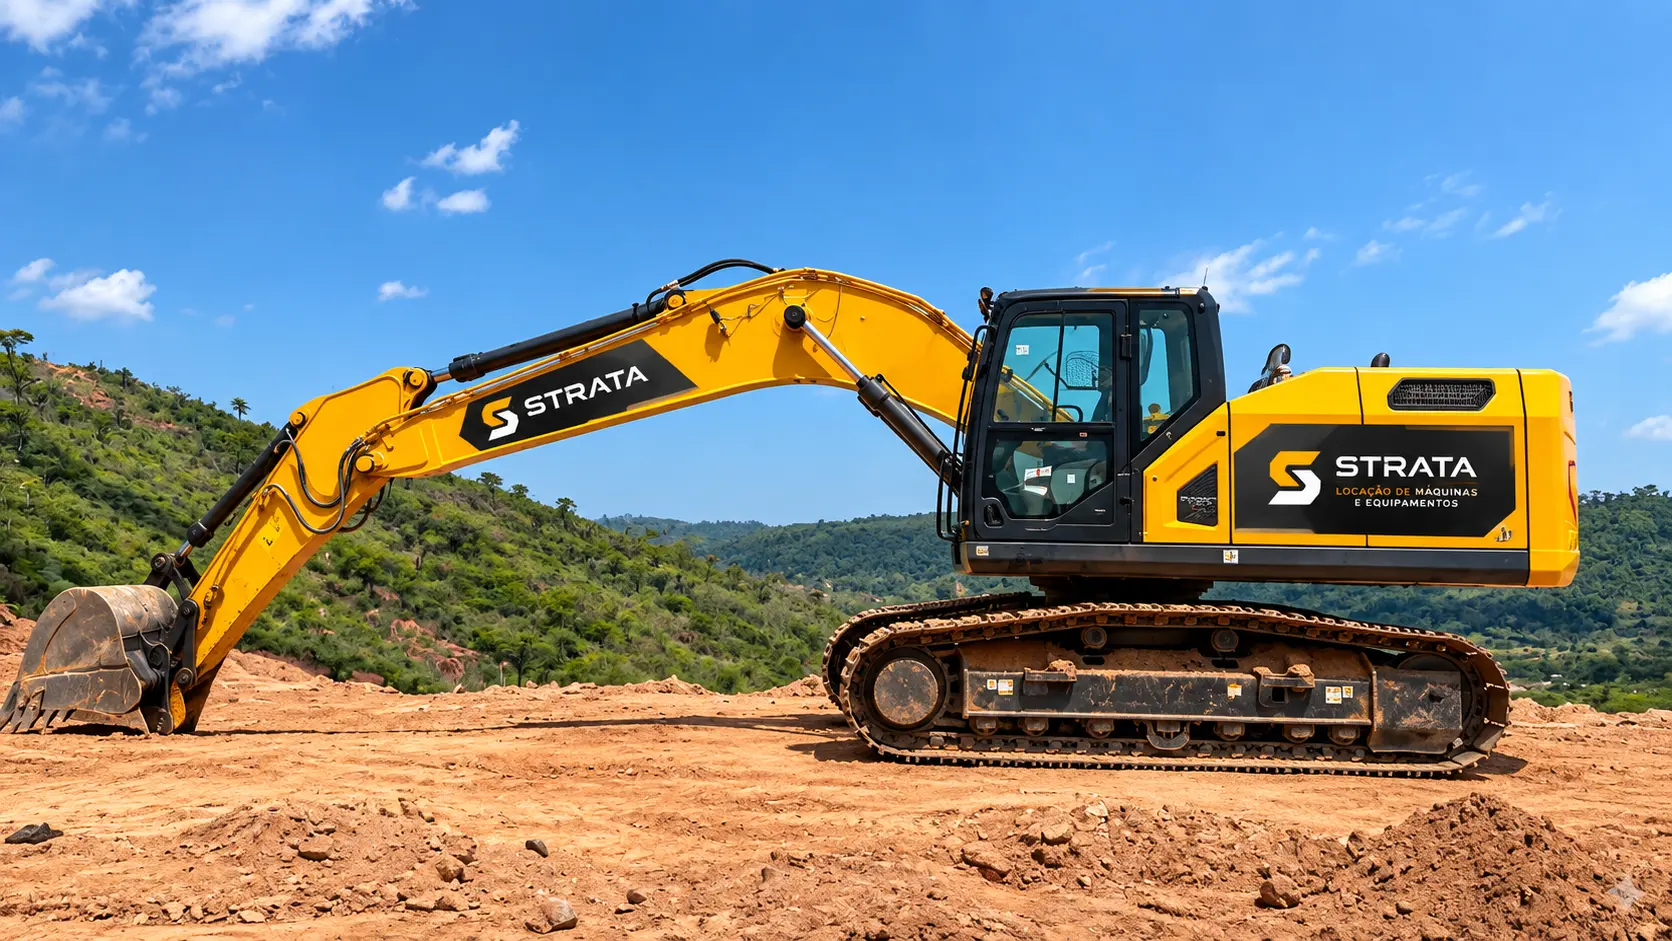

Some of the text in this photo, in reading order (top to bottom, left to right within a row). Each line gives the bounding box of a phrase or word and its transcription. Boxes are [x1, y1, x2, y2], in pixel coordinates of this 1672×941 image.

[524, 365, 649, 417] STRATA
[1336, 455, 1478, 478] STRATA
[1335, 484, 1478, 497] LOCAÇÃO DE MÁQUINAS
[1354, 498, 1459, 508] E EQUIPAMENTOS
